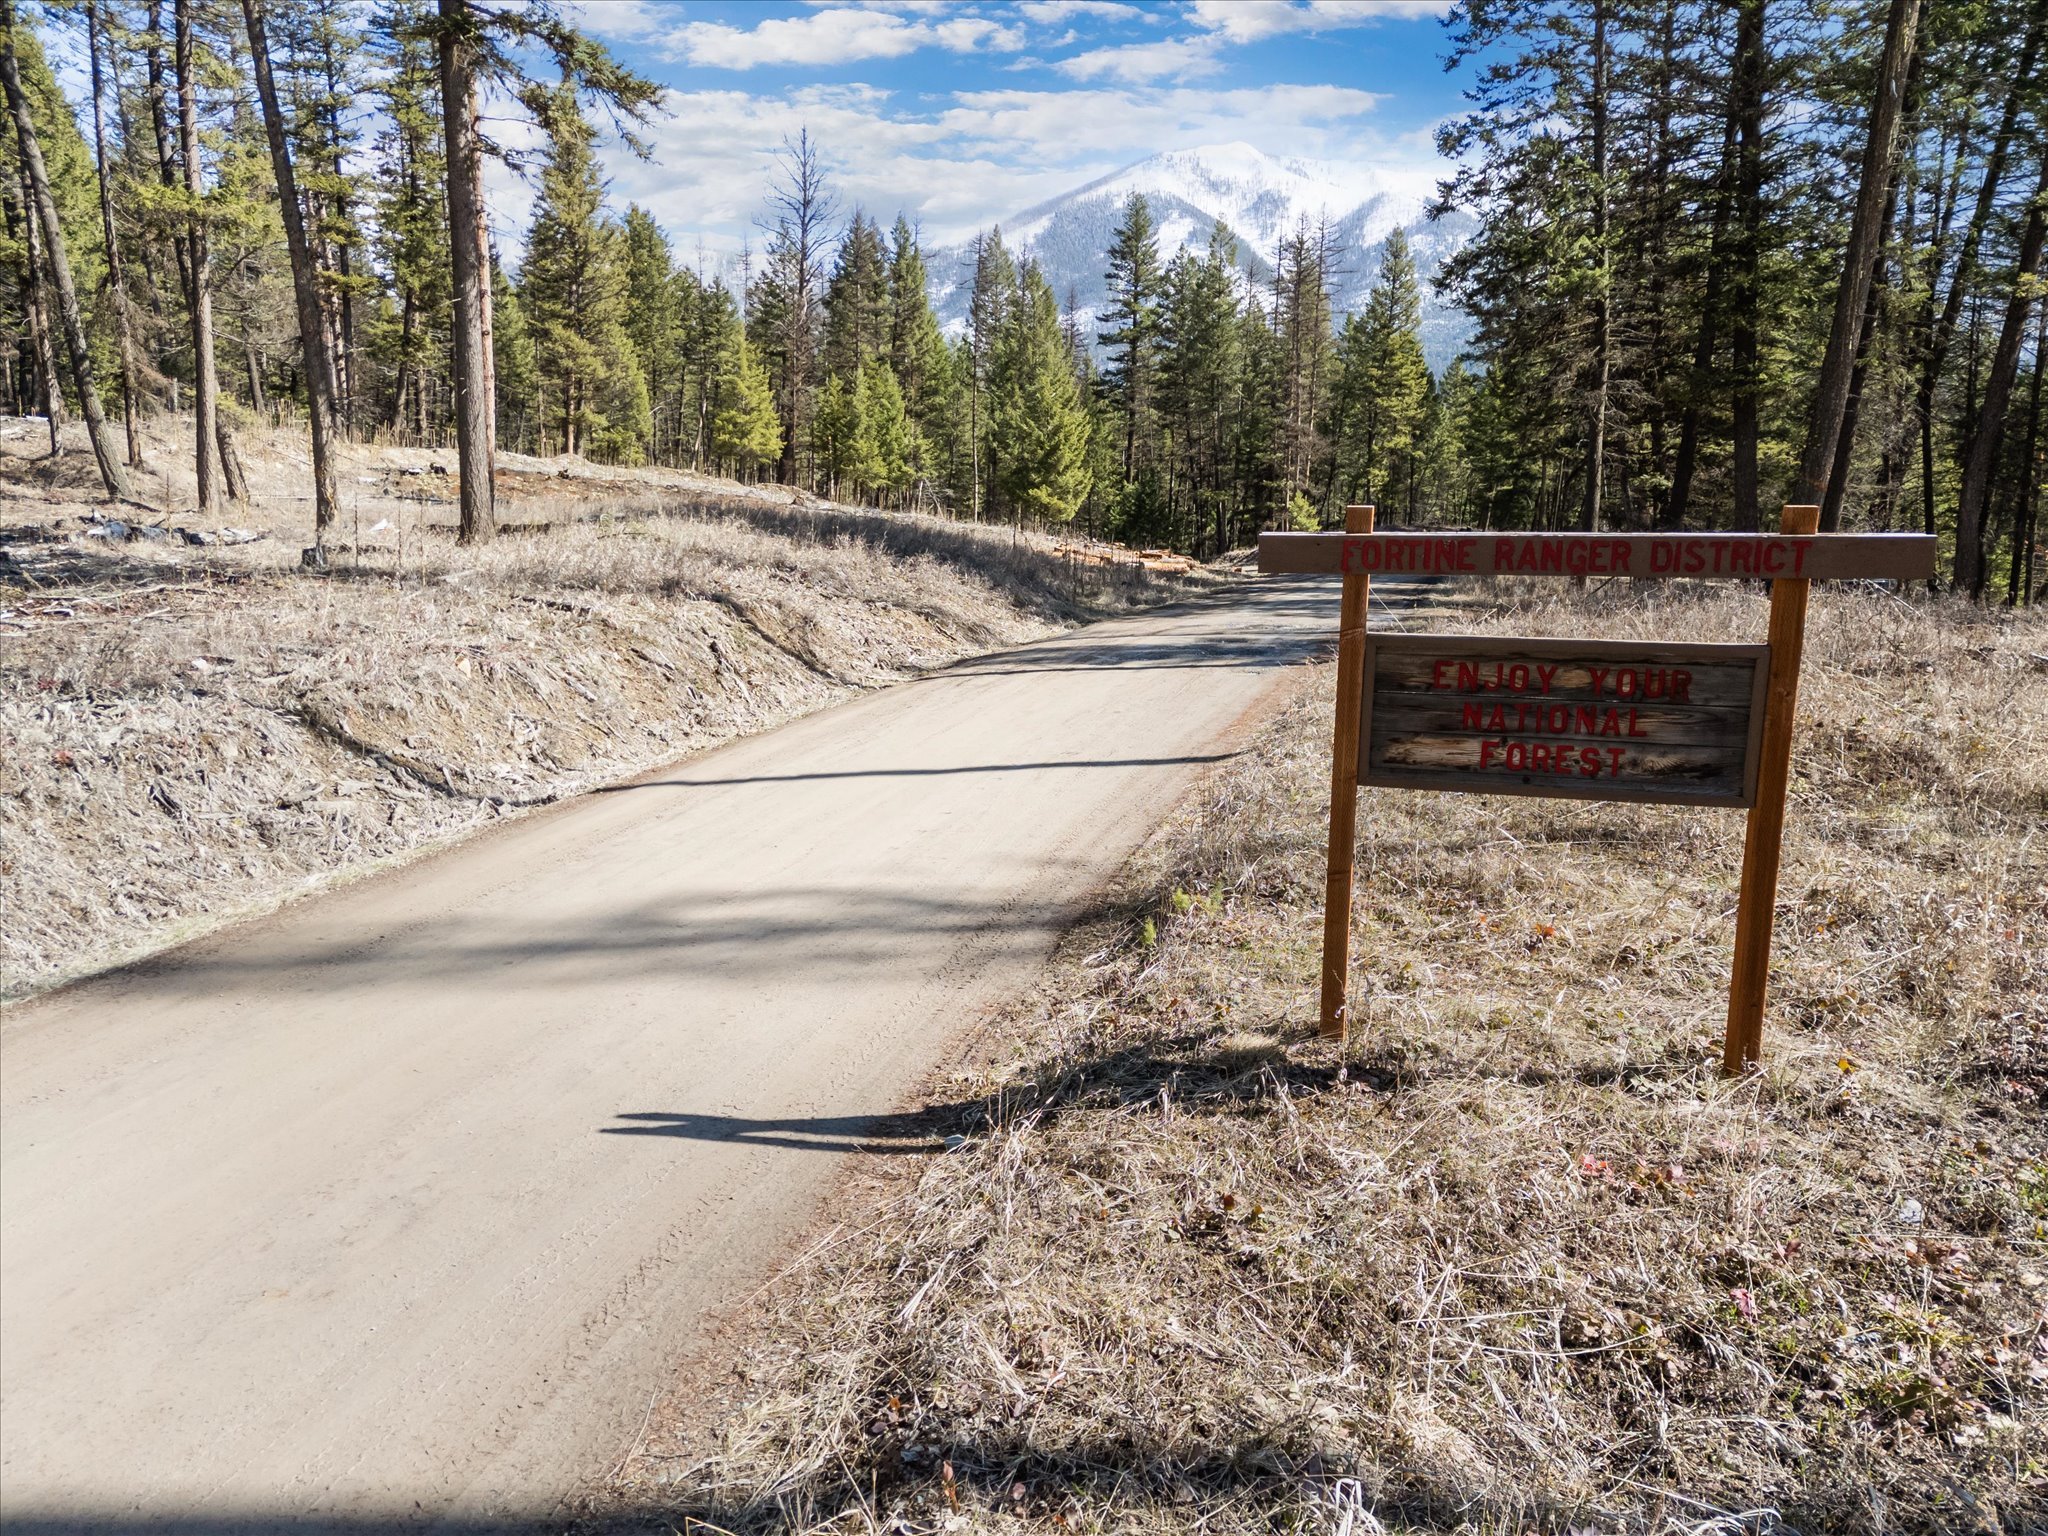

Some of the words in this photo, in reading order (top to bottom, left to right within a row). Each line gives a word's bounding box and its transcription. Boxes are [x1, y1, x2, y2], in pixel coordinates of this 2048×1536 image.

[1341, 538, 1477, 573] FORTINE
[1494, 538, 1633, 574] RANGER
[1650, 540, 1813, 577] DISTRICT
[1433, 660, 1558, 695] ENJOY
[1588, 667, 1694, 703] YOUR
[1463, 703, 1648, 738] NATIONAL
[1479, 740, 1627, 777] FOREST
